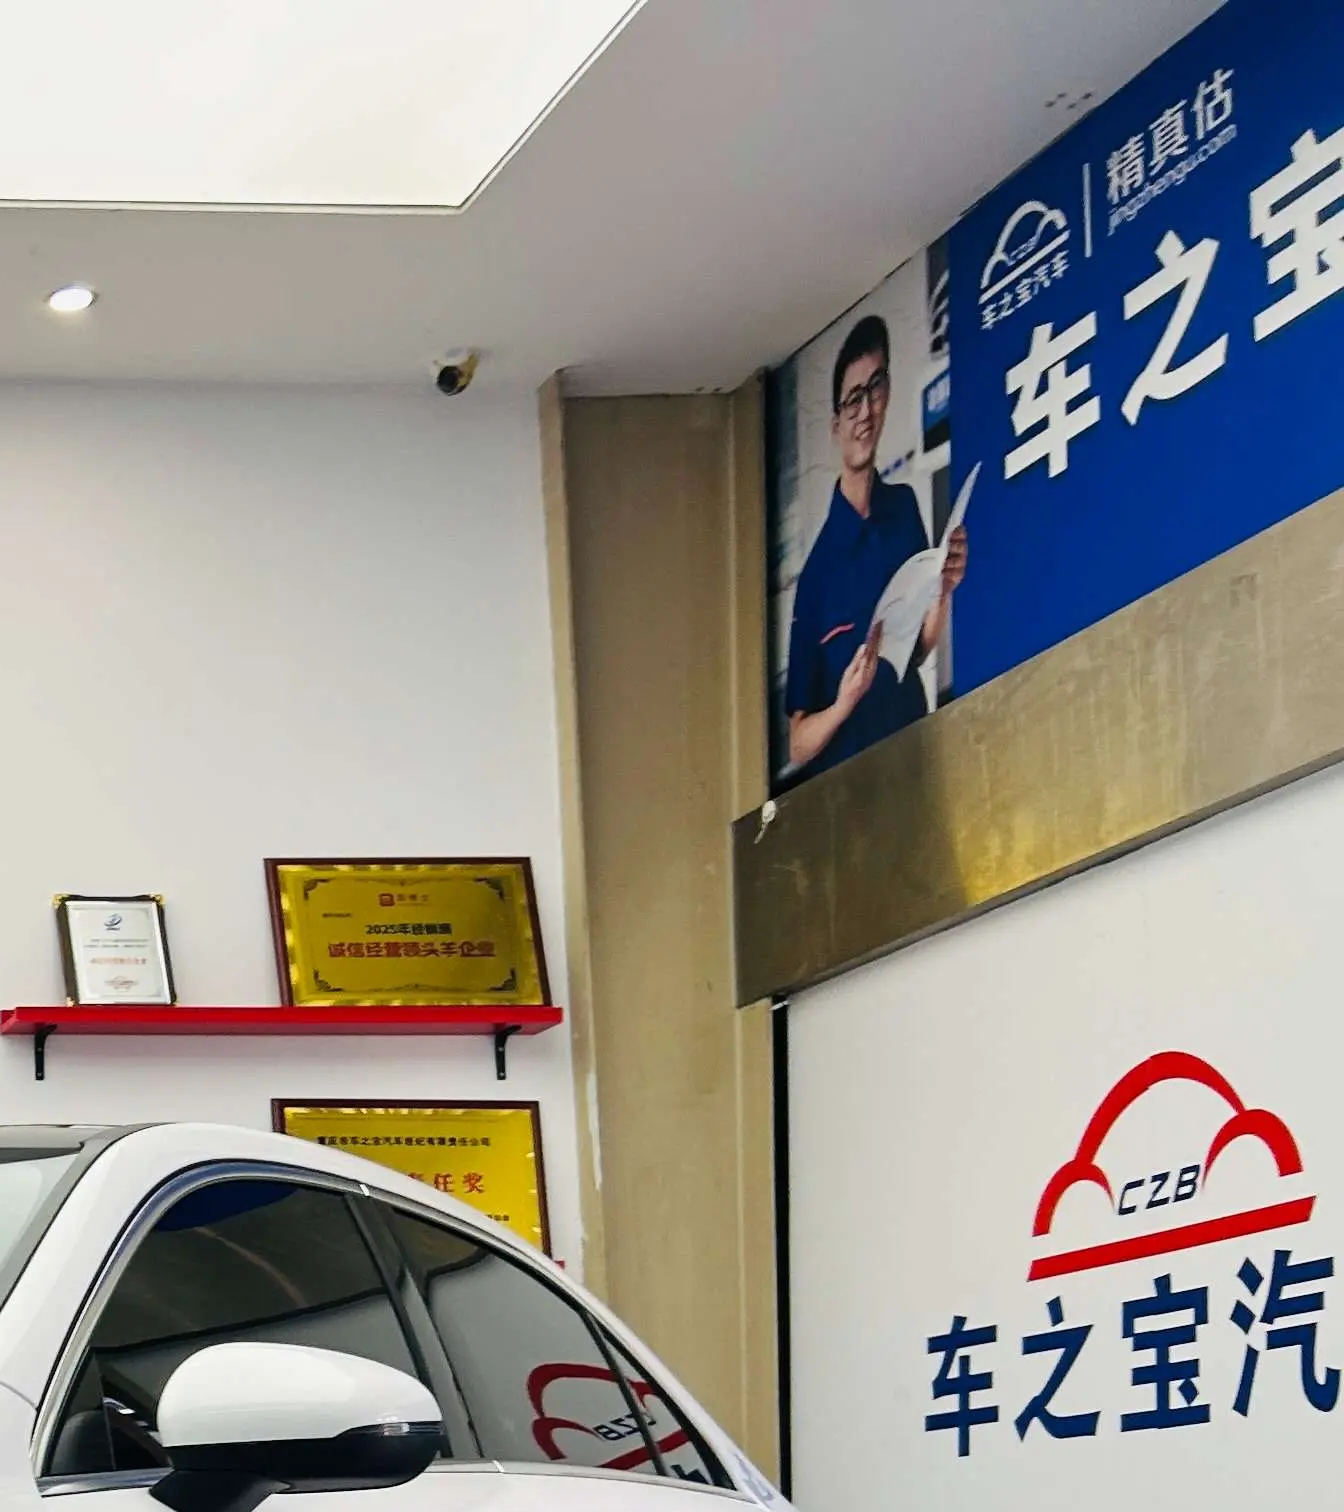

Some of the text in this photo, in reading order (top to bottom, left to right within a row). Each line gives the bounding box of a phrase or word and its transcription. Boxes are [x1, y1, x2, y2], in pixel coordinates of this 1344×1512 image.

[1106, 69, 1234, 205] 精真估
[980, 249, 1071, 330] 车之宝汽车
[1004, 126, 1344, 480] 车之宝
[1118, 1164, 1201, 1215] CZB
[924, 1249, 1342, 1457] 车之宝汽
